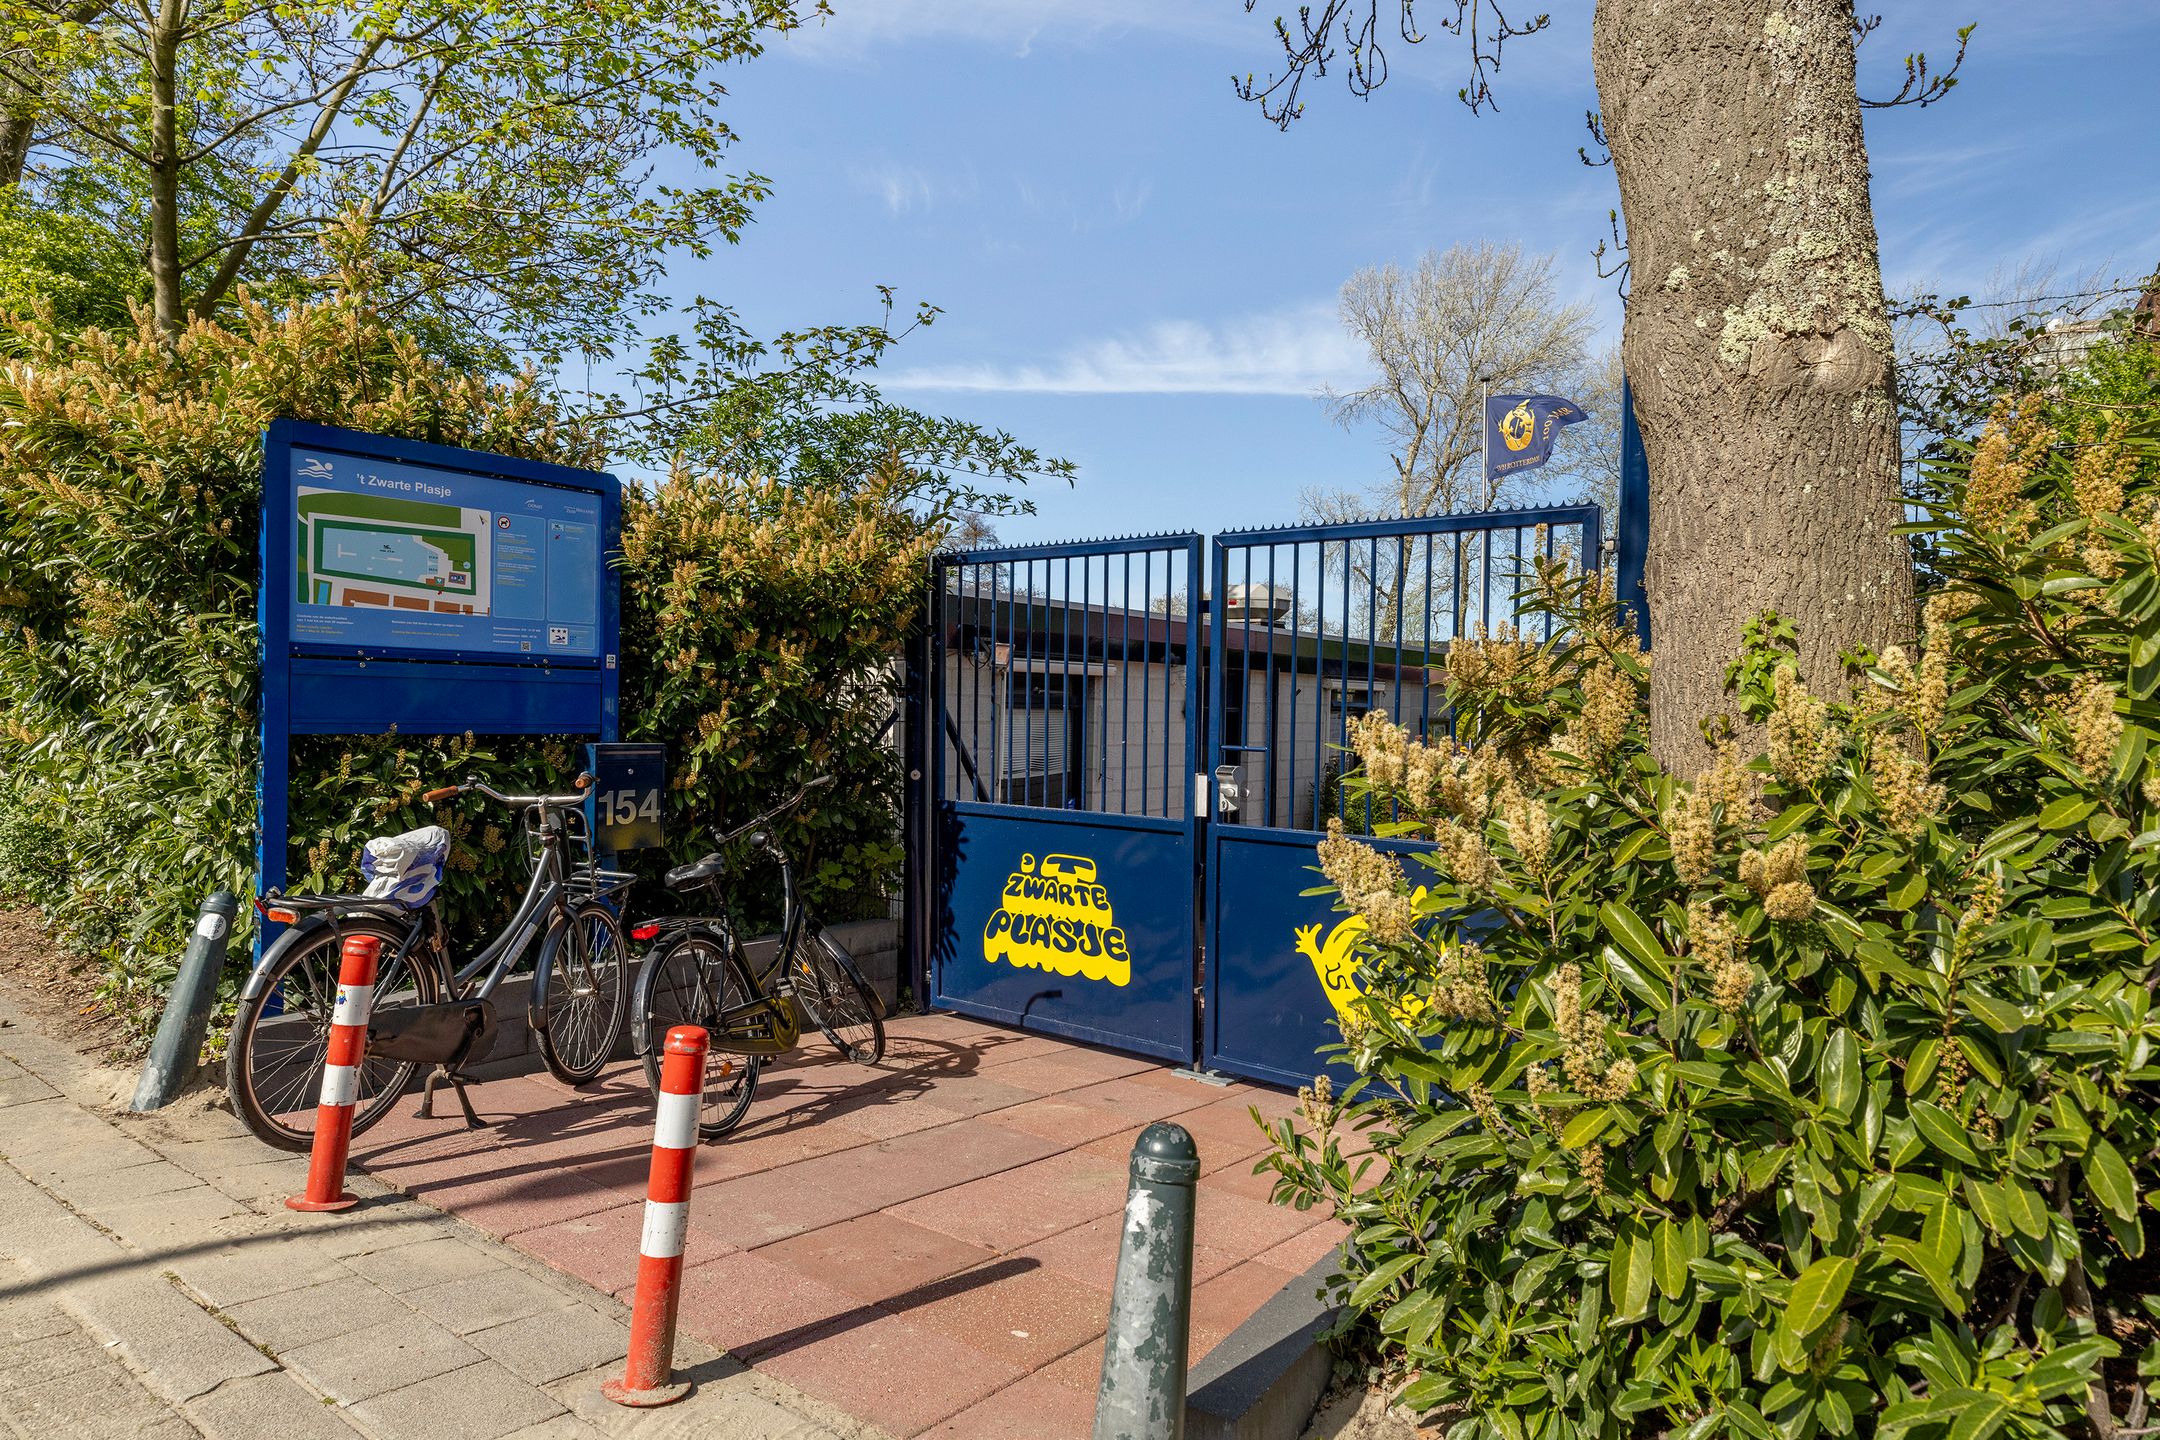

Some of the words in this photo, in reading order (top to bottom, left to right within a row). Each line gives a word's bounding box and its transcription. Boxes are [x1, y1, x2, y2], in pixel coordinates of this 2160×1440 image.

[367, 475, 412, 491] Zwarte
[415, 482, 452, 498] Plasje
[598, 788, 661, 826] 154
[1004, 875, 1110, 911] ZWARTE
[985, 909, 1129, 962] PLASJE
